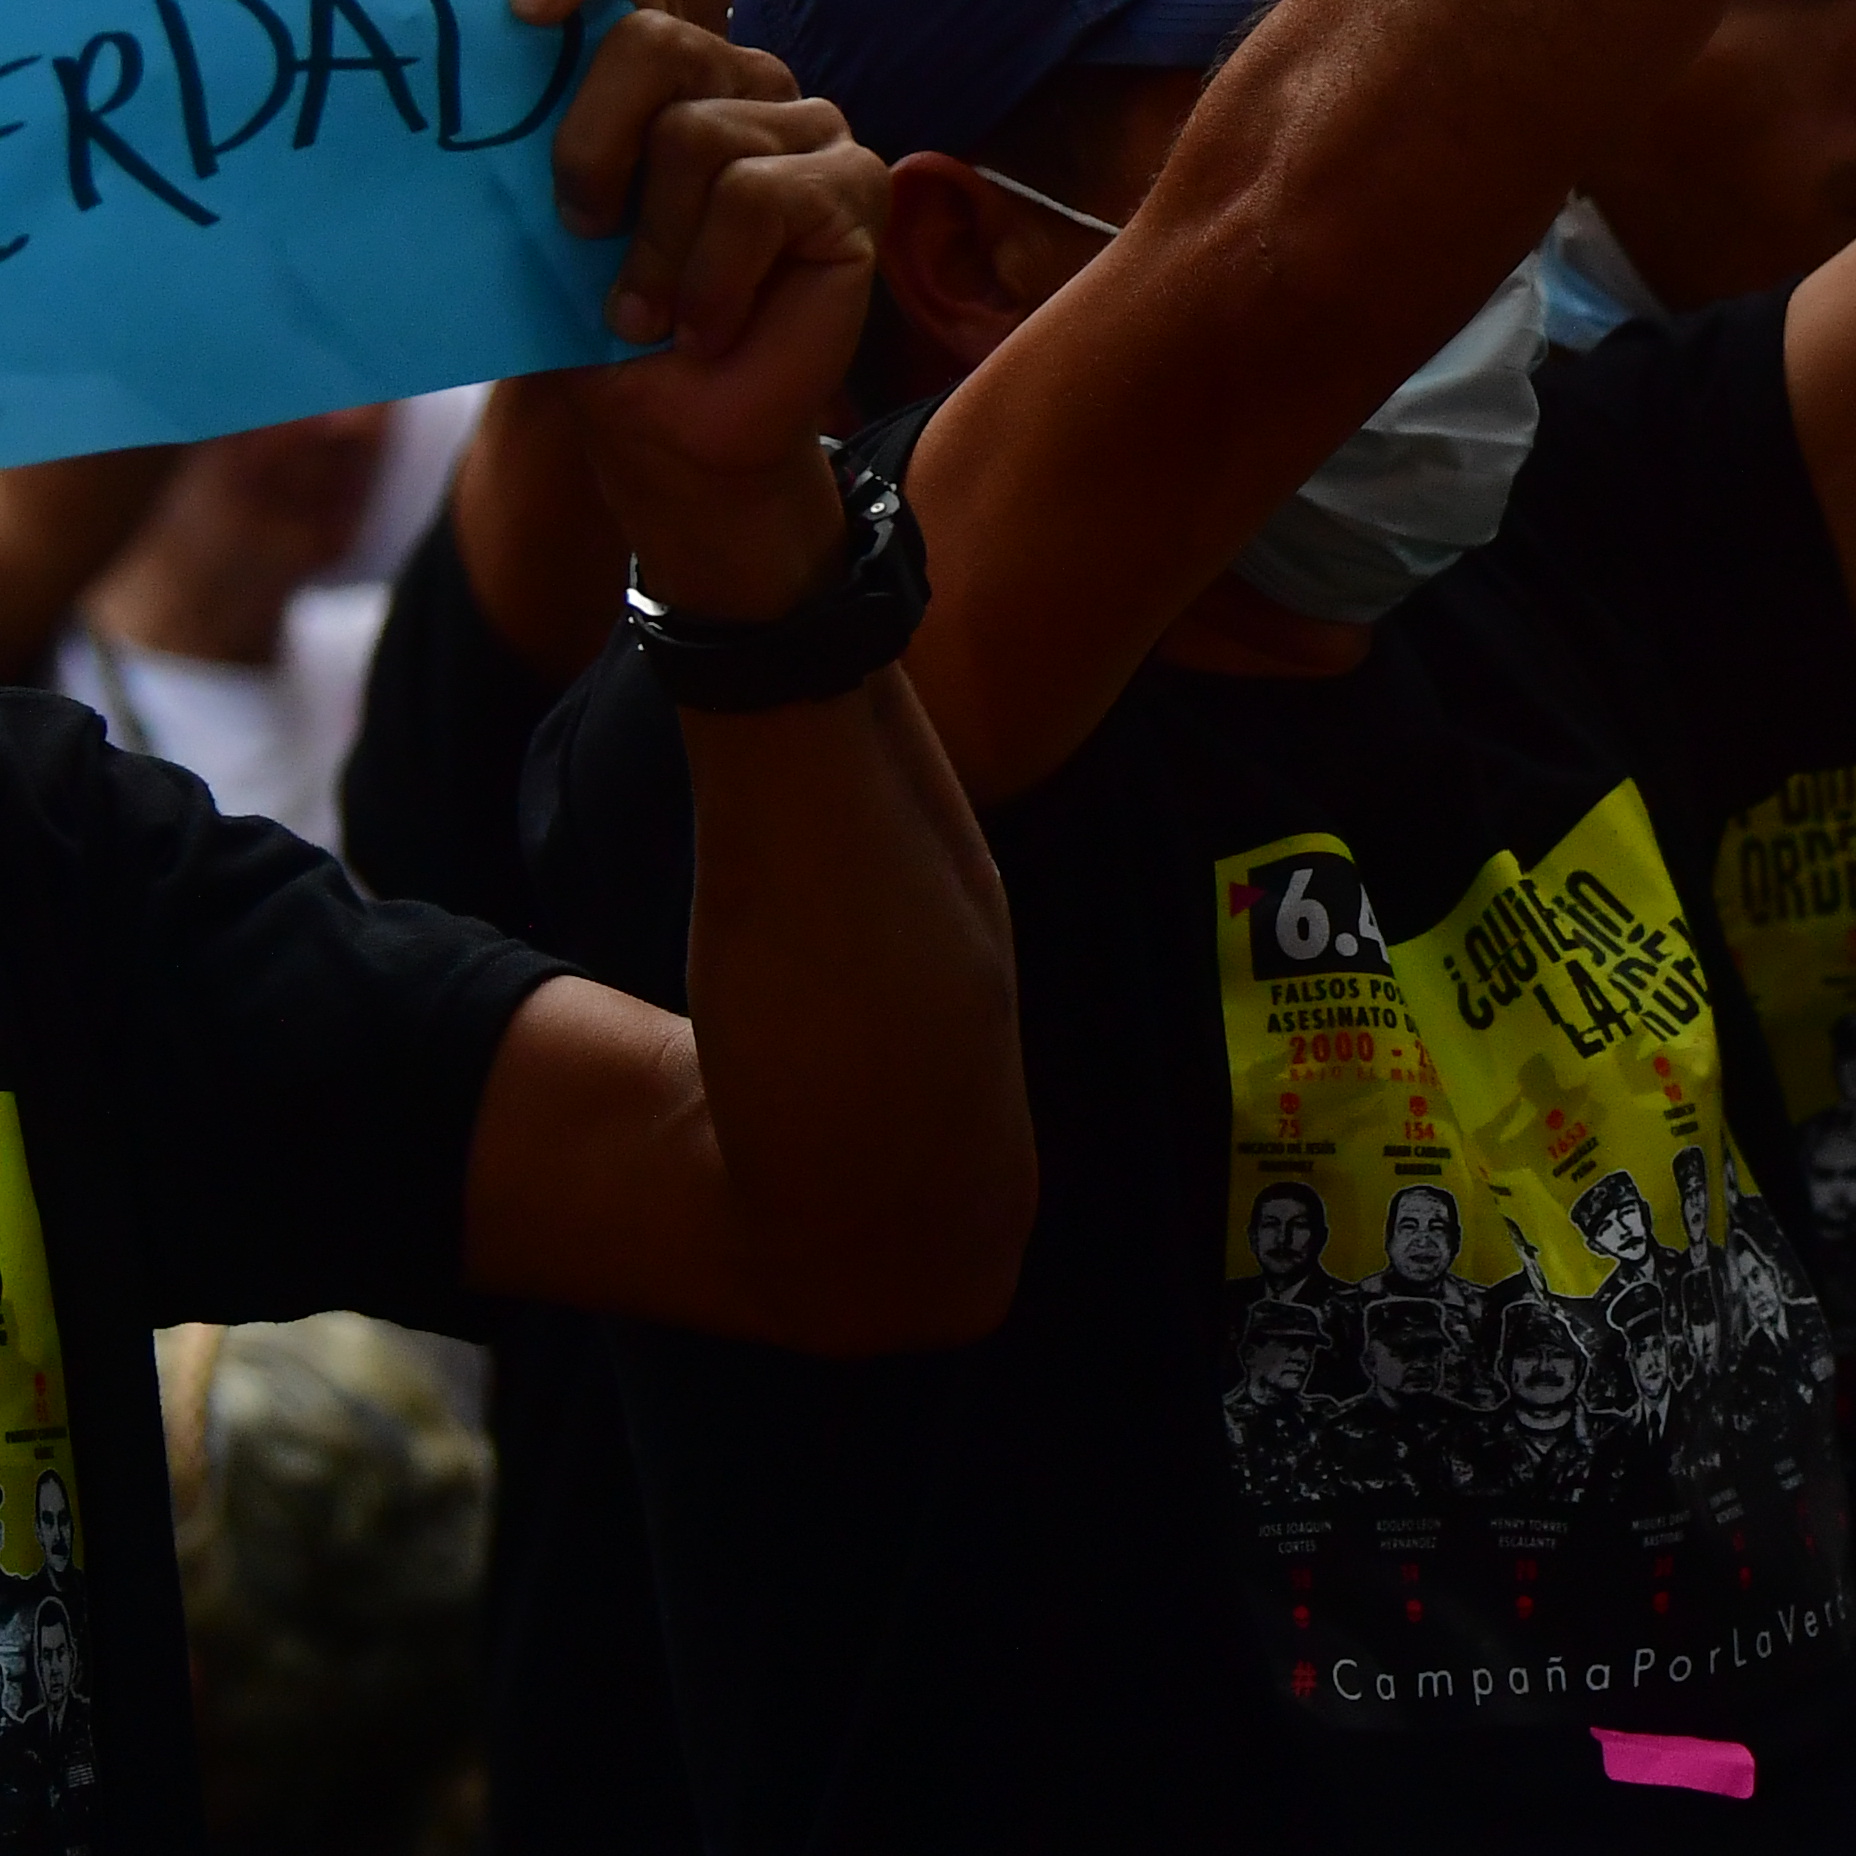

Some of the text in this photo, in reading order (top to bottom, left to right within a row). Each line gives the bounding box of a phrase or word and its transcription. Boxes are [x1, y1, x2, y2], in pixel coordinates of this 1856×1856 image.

[1271, 978, 1360, 1006] FALSOS
[1267, 1007, 1398, 1033] ASESINATO
[1289, 1031, 1375, 1065] 2000
